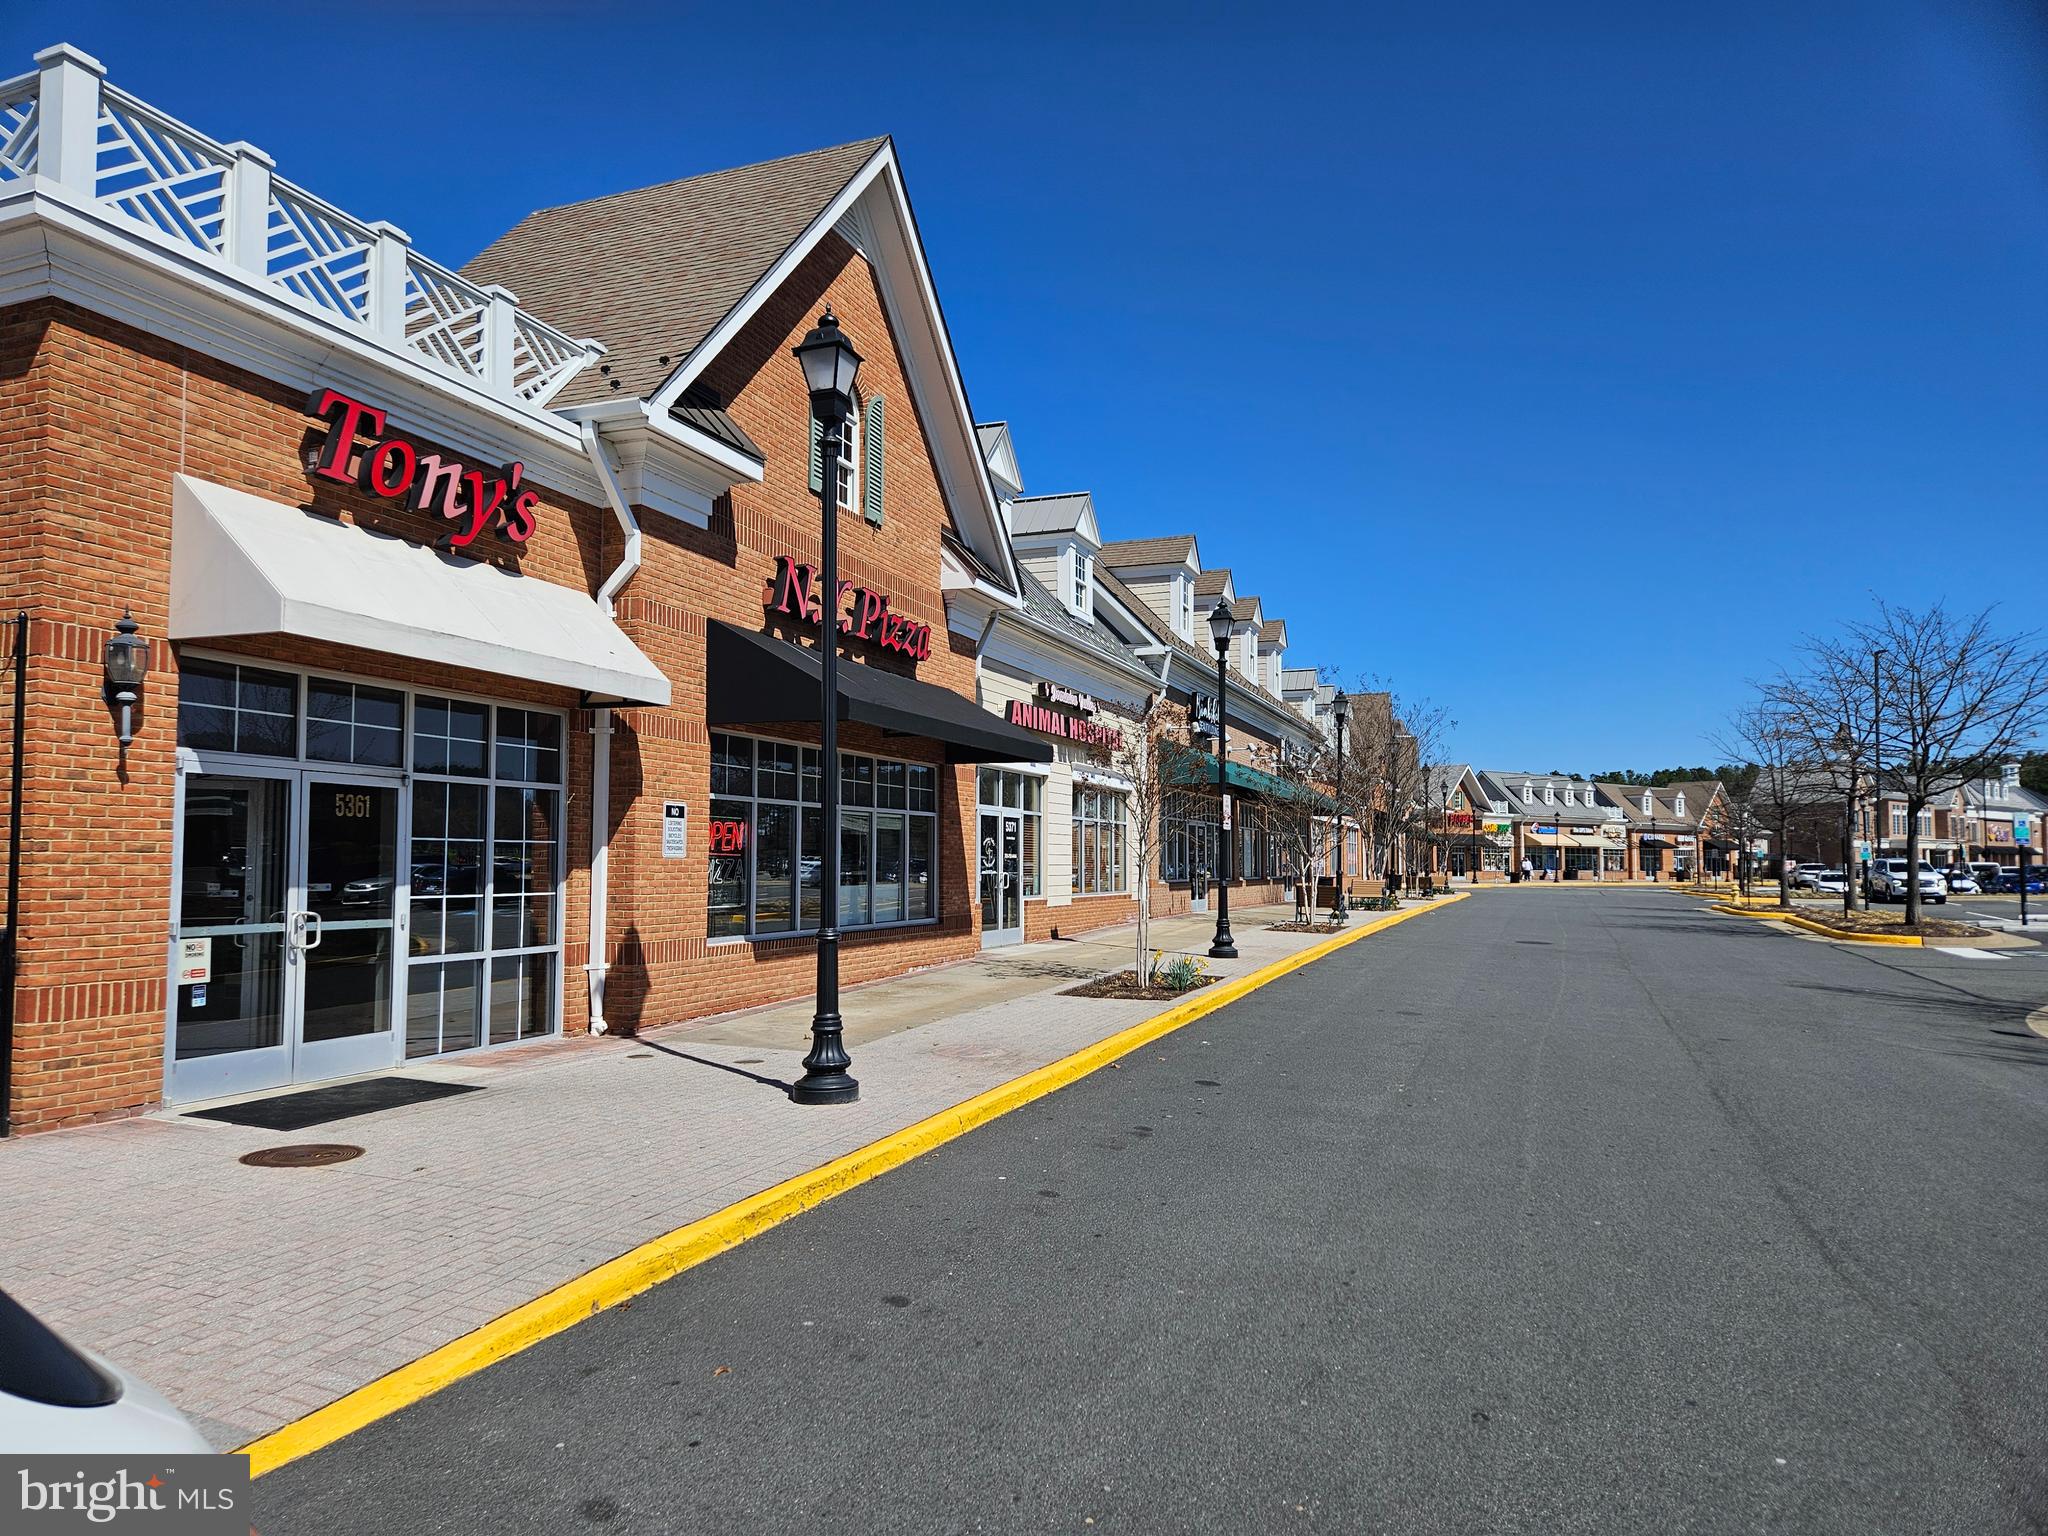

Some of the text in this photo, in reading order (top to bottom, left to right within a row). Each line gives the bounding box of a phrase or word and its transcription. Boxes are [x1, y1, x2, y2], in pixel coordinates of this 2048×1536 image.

[312, 387, 540, 547] Tony's
[855, 586, 932, 662] Pizza
[1010, 700, 1123, 752] ANIMAL HOSPITAL
[335, 793, 371, 818] 5361
[671, 807, 679, 816] NO
[709, 821, 744, 851] PEN
[1005, 821, 1017, 833] 5371
